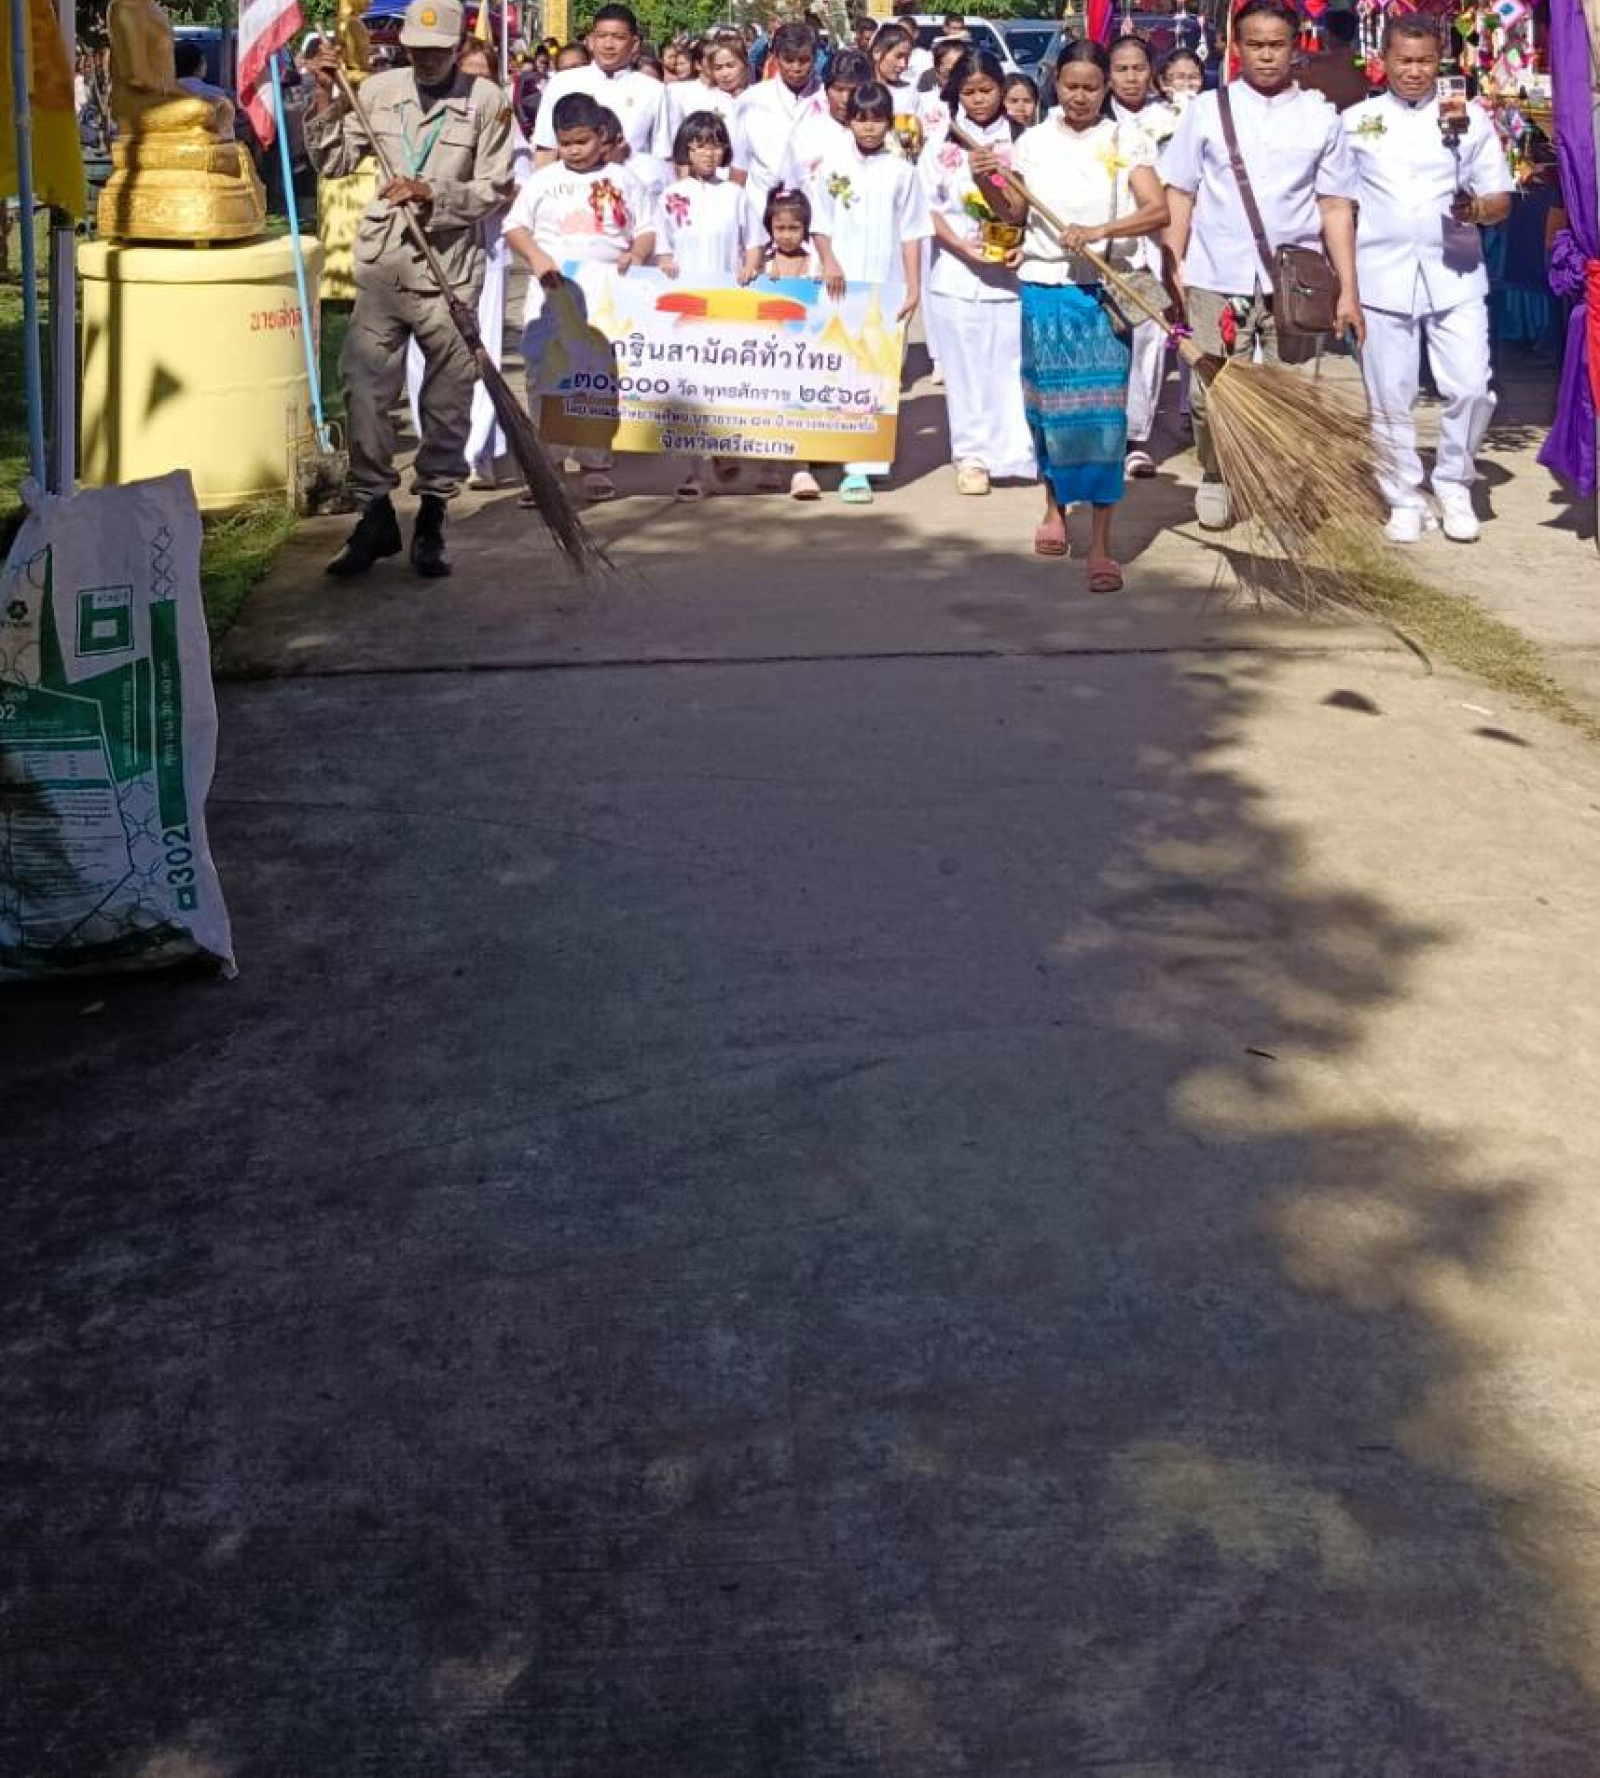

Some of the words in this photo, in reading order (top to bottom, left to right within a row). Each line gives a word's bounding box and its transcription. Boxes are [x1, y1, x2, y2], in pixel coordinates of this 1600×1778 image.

[611, 332, 842, 371] กฐินสามัคคีทั่วไทย
[661, 429, 795, 455] จังหวัดศรีสะเกษ
[164, 824, 194, 886] 302
